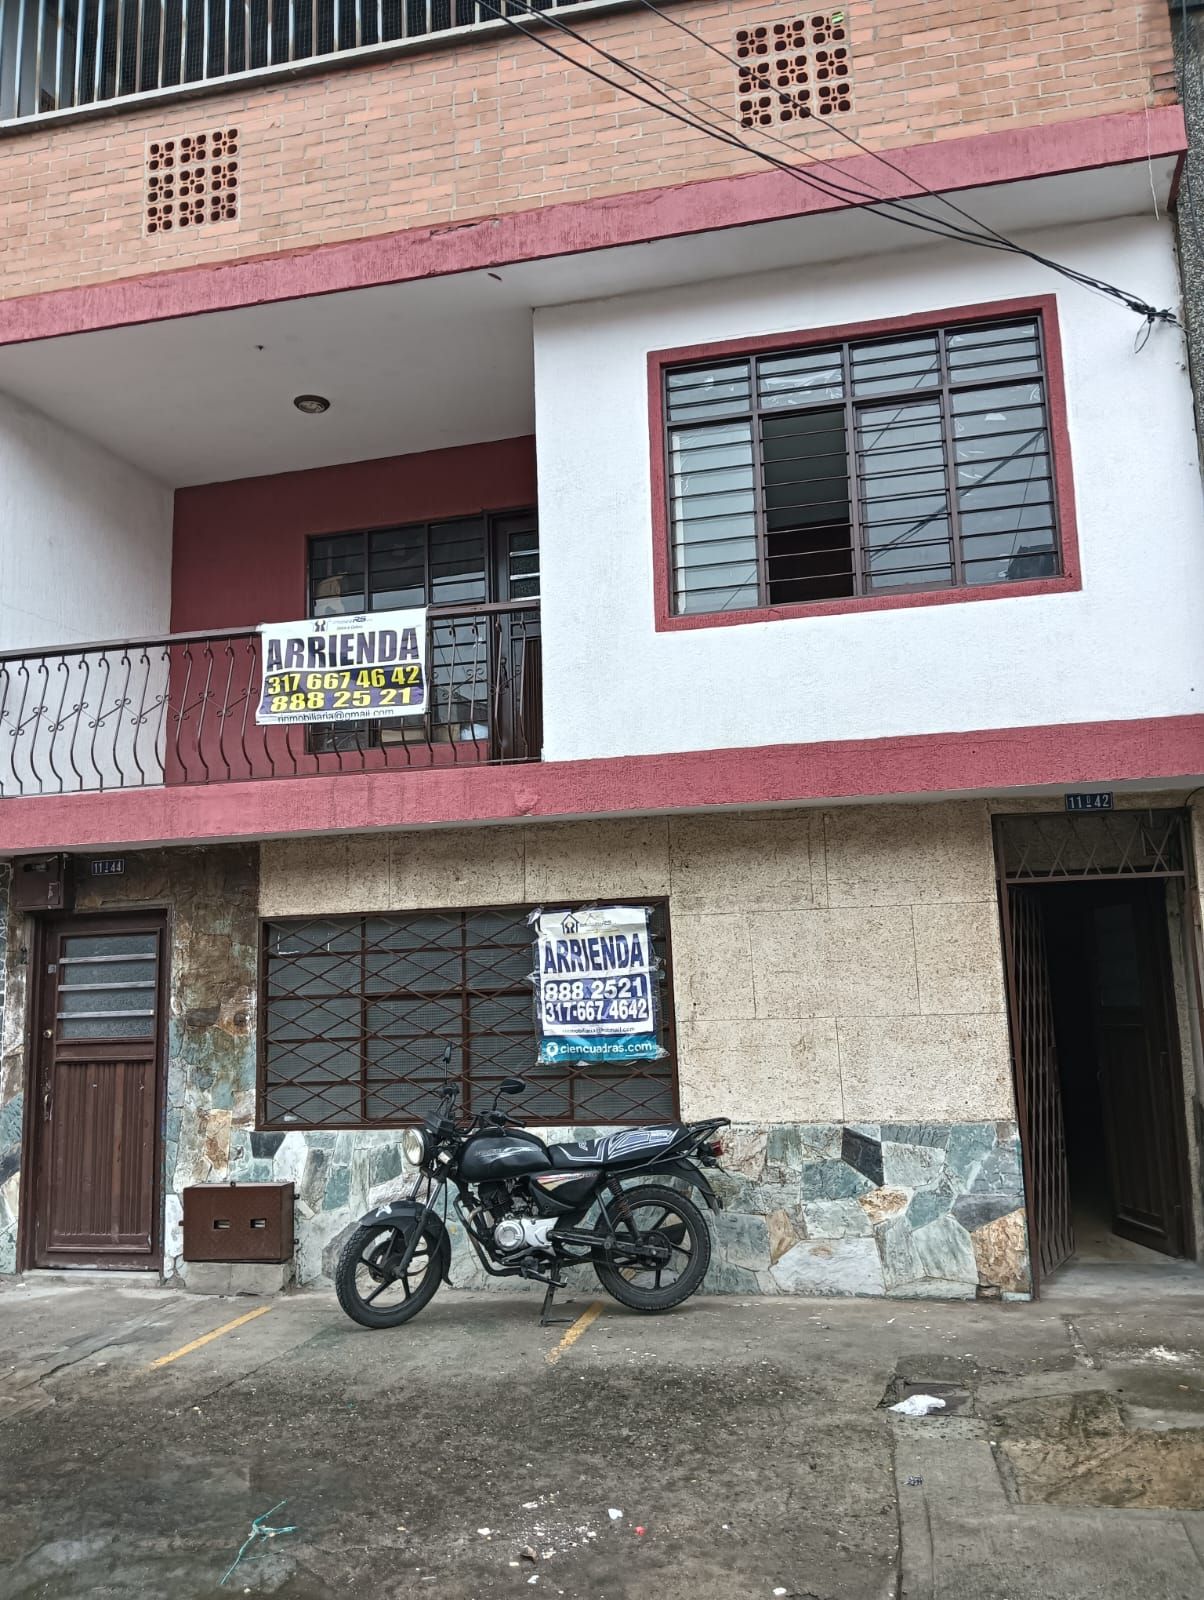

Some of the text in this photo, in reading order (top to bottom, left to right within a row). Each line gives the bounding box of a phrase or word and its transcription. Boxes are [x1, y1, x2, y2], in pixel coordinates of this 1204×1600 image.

[267, 627, 420, 672] ARRIENDA
[268, 665, 420, 695] 317 667 46 42
[270, 687, 412, 712] 888 25 21
[543, 933, 645, 975] ARRIENDA
[545, 977, 643, 1002] 888 2521
[609, 998, 648, 1020] 4642
[560, 1042, 653, 1054] ciencuadras.com
